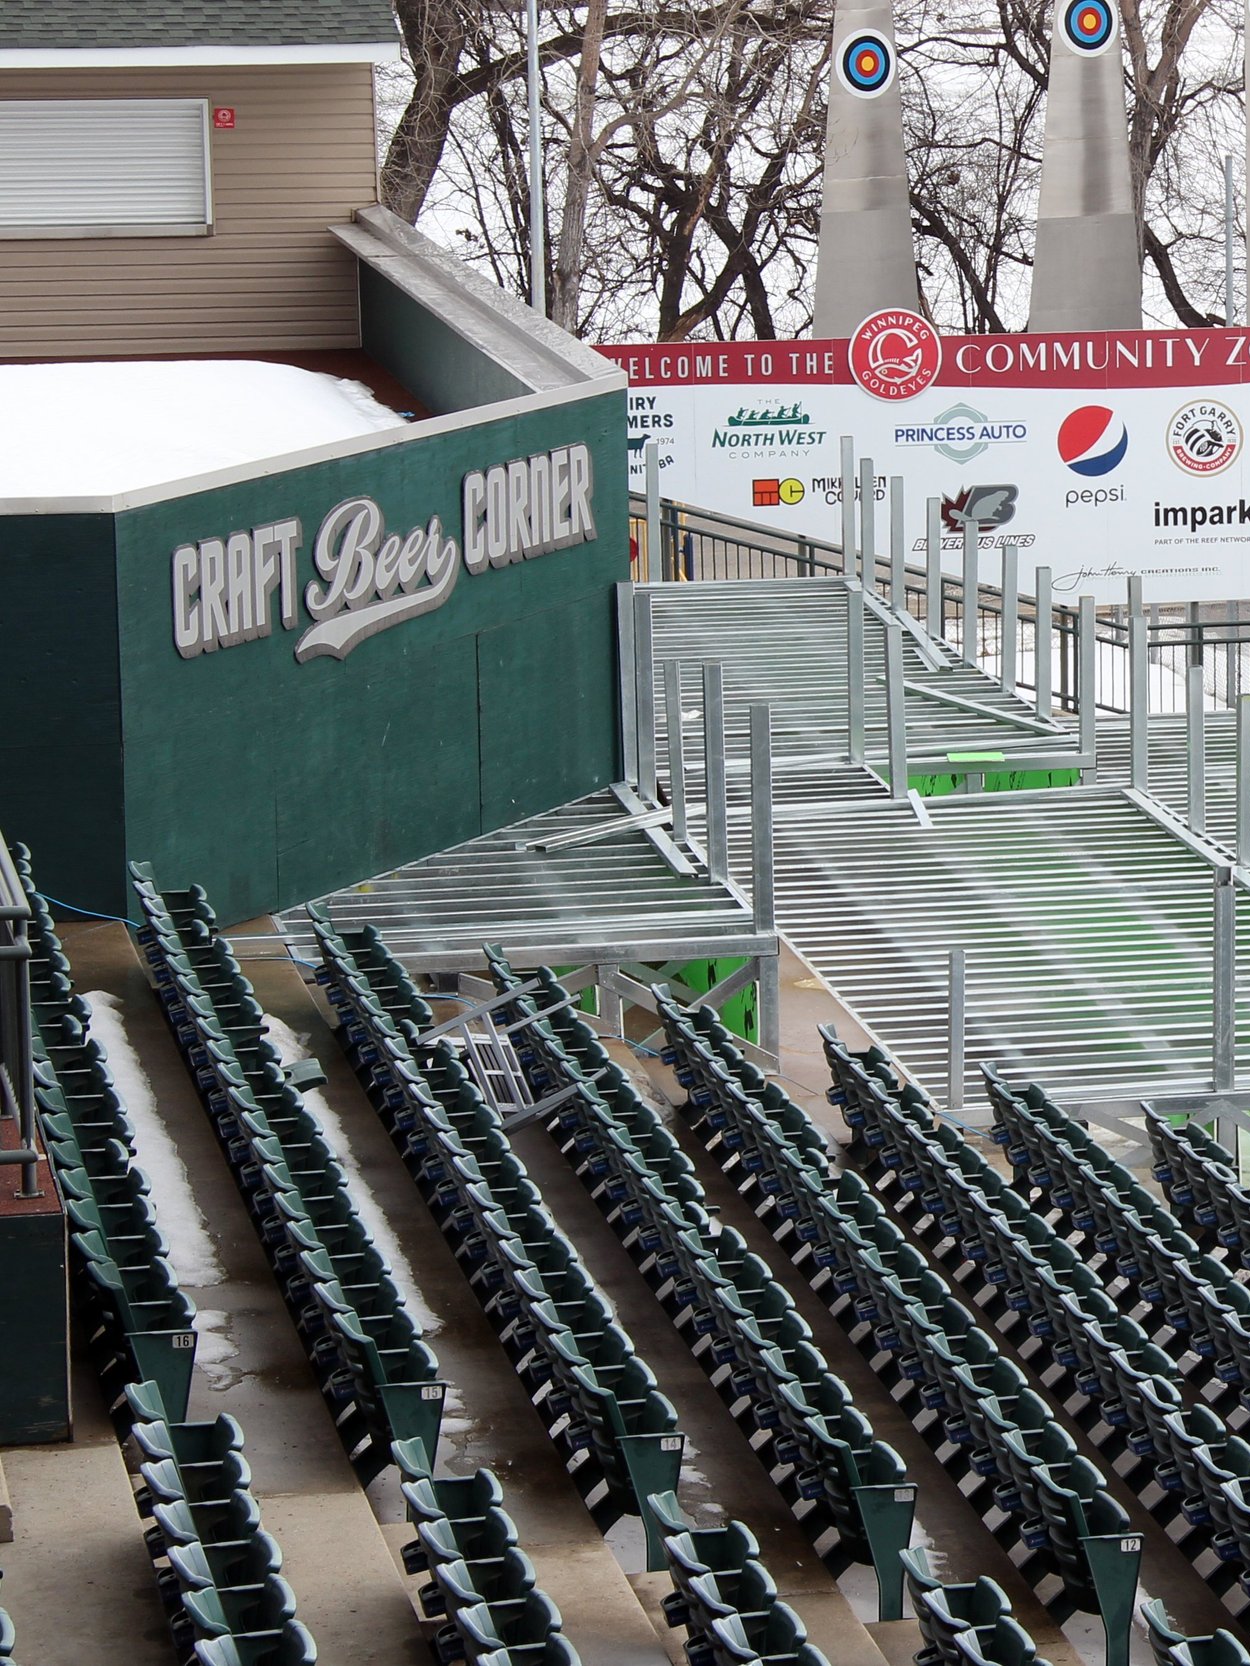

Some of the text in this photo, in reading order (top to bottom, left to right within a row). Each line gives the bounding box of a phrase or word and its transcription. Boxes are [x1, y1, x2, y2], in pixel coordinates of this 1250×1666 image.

[861, 315, 930, 341] WINNIPEG
[744, 353, 772, 378] TO
[789, 351, 834, 376] THE
[956, 337, 1210, 373] COMMUNITY
[862, 368, 932, 396] GOLDEYES
[629, 396, 656, 411] IRY
[628, 414, 674, 429] MERS
[1173, 405, 1236, 437] FORT GARRY
[656, 437, 675, 446] 1974
[712, 428, 827, 448] NORTH WEST
[895, 424, 1027, 443] PRINCESS AUTO
[630, 454, 675, 475] NIBA
[729, 450, 811, 460] COMPANY
[1175, 447, 1233, 470] BREWING COMPANY
[1065, 484, 1125, 508] pepsi
[172, 441, 598, 658] CRAFT Beer CORNER
[995, 534, 1036, 549] LINES
[1155, 538, 1172, 546] PART
[176, 1335, 189, 1347] 16
[424, 1387, 438, 1399] 15
[663, 1438, 677, 1450] 14
[1124, 1539, 1137, 1551] 12
